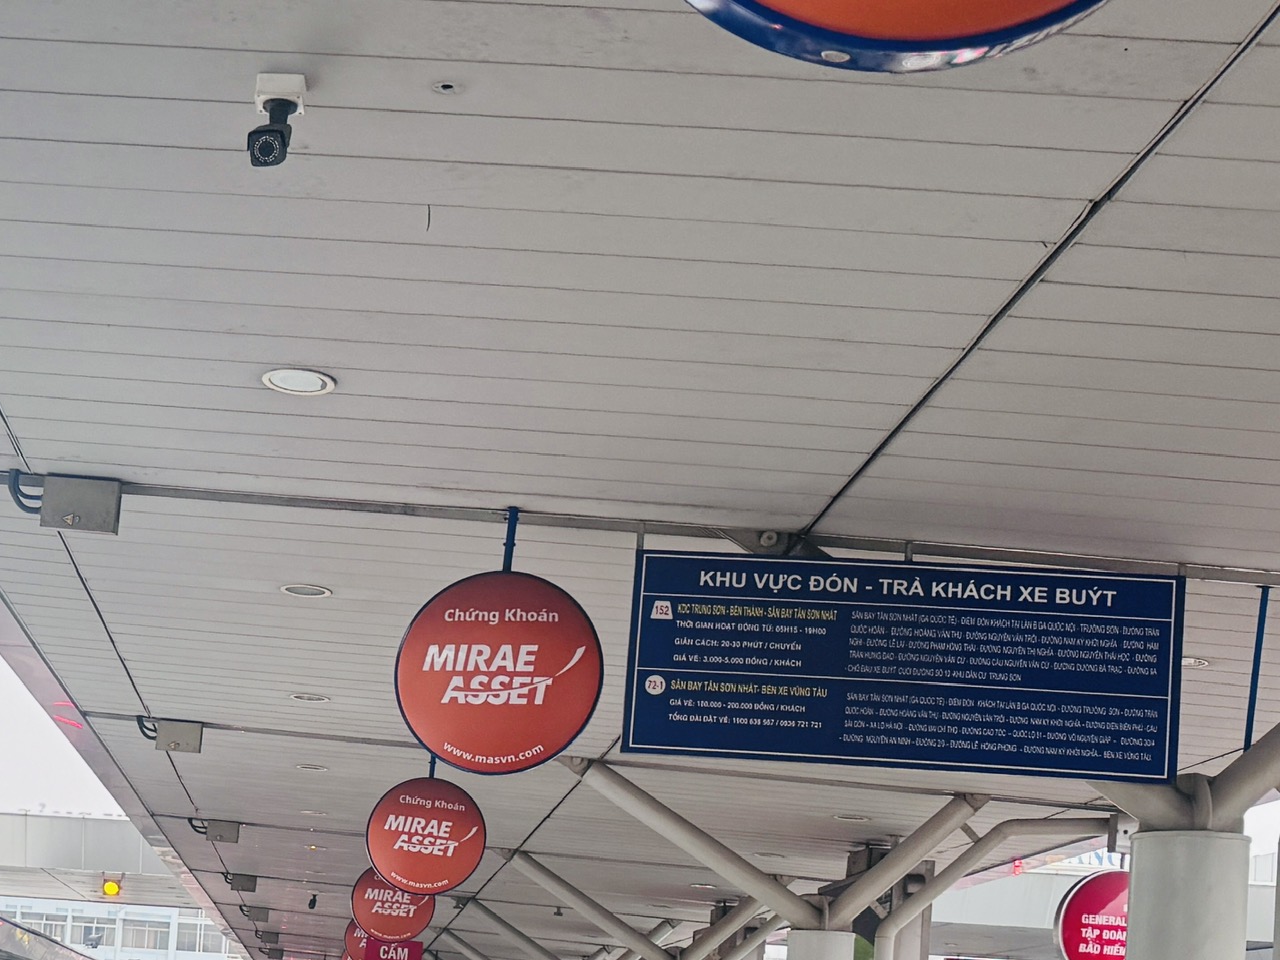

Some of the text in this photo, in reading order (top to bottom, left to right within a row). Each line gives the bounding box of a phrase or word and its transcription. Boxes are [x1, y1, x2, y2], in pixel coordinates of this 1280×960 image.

[699, 571, 1117, 607] KHU VỰC ĐÓN TRẢ KHÁCH XE BUÝT
[444, 608, 559, 625] Chứng Khoán
[654, 604, 669, 615] 152
[422, 644, 539, 672] MIRAE
[440, 675, 553, 705] ASSET
[646, 679, 663, 690] 72-1
[686, 680, 702, 691] BAY
[777, 685, 788, 695] XE
[443, 741, 544, 764] www.masvn.com
[399, 794, 466, 812] Chứng Khoán
[384, 814, 453, 838] MIRAE
[393, 834, 459, 857] ASSET
[364, 887, 412, 904] MIRAE
[371, 901, 417, 918] ASSET
[1081, 914, 1128, 927] GENERAL
[1080, 927, 1100, 941] TẬP
[379, 942, 409, 960] CẤM
[1078, 942, 1101, 955] BẢO
